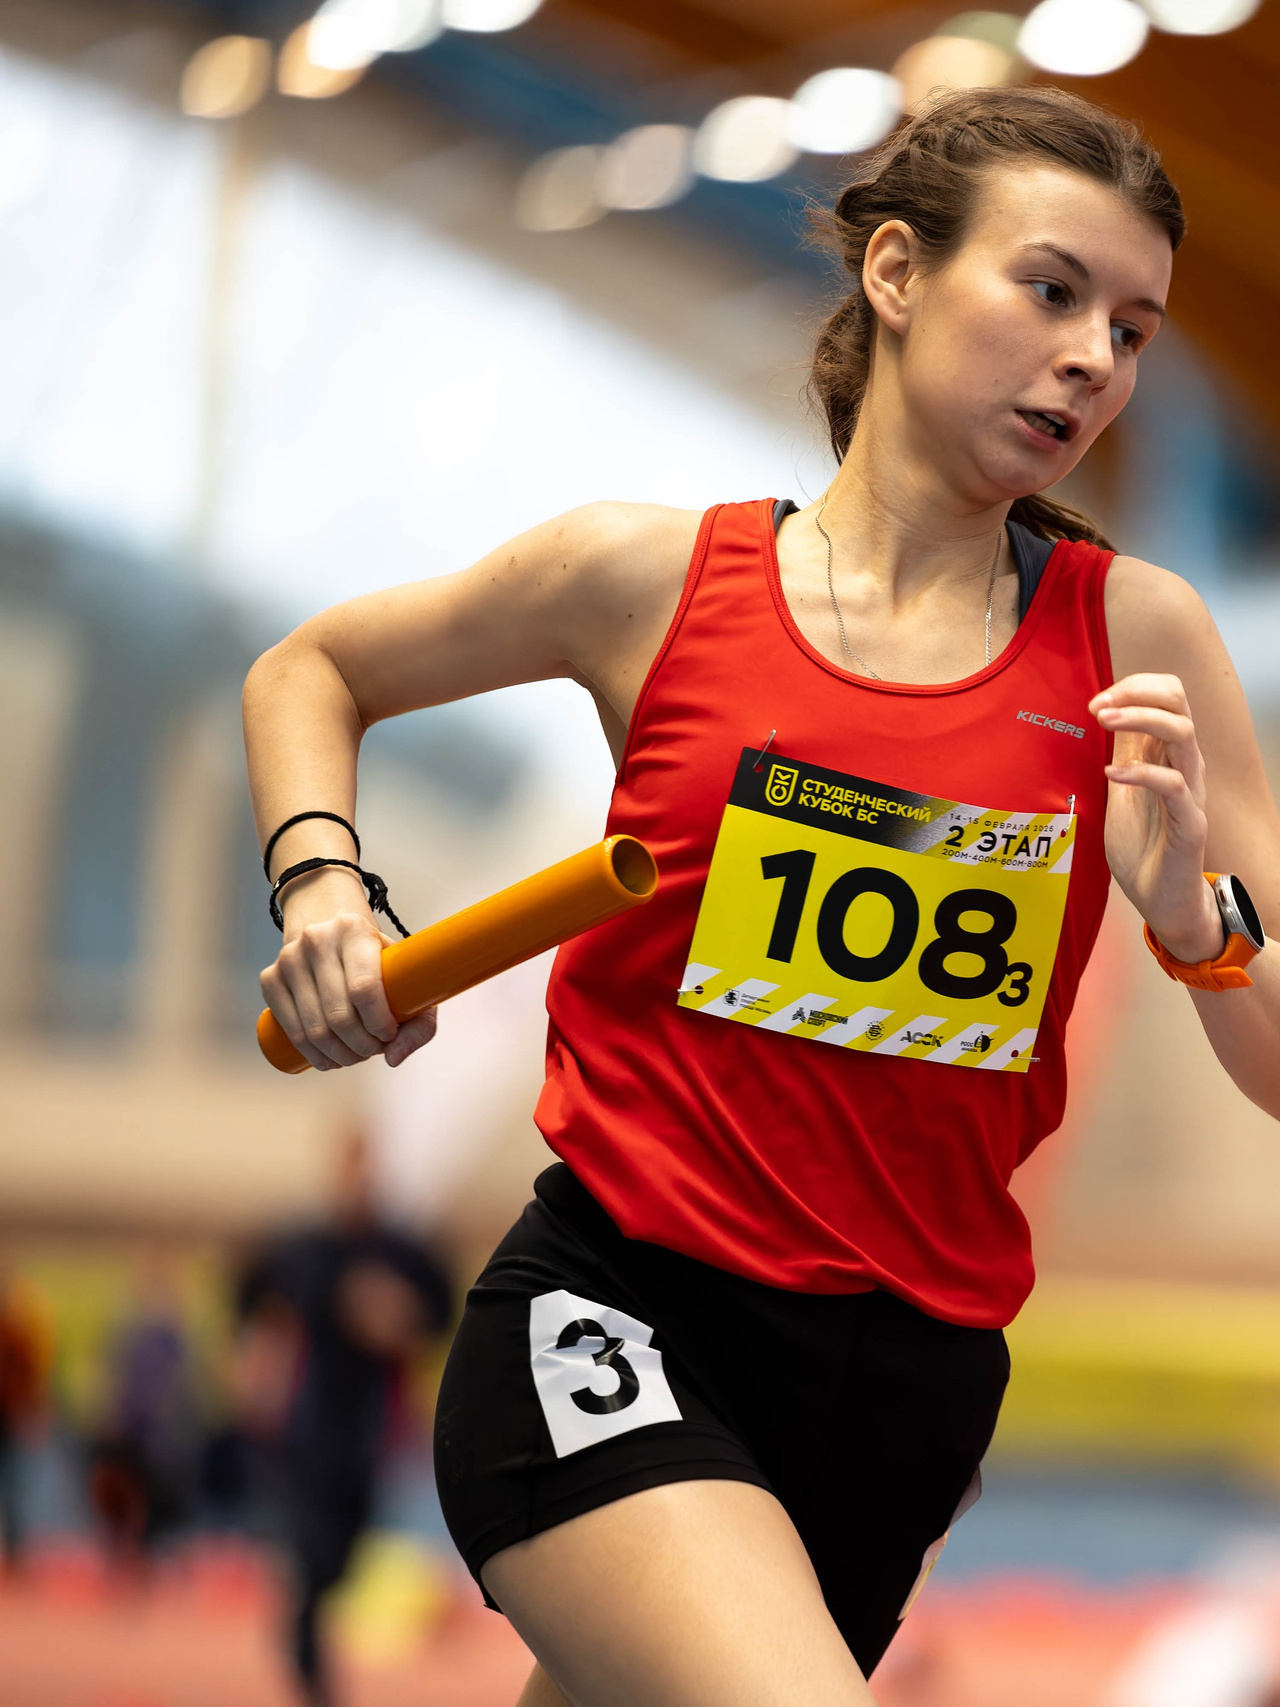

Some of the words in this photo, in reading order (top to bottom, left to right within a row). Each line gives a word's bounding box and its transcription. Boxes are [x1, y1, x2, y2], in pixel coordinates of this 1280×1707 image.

[1016, 710, 1086, 739] KICKERS
[798, 793, 855, 819] КУБОК
[856, 808, 879, 825] БС
[802, 779, 932, 823] СТУДЕНЧЕСКИЙ
[950, 813, 979, 825] 14-15
[984, 820, 1030, 831] ФЕВРАЛЯ
[945, 825, 965, 847] 2
[976, 831, 1052, 858] ЭТАП
[760, 849, 1017, 999] 108
[997, 961, 1034, 1007] 3
[556, 1318, 640, 1415] 3
